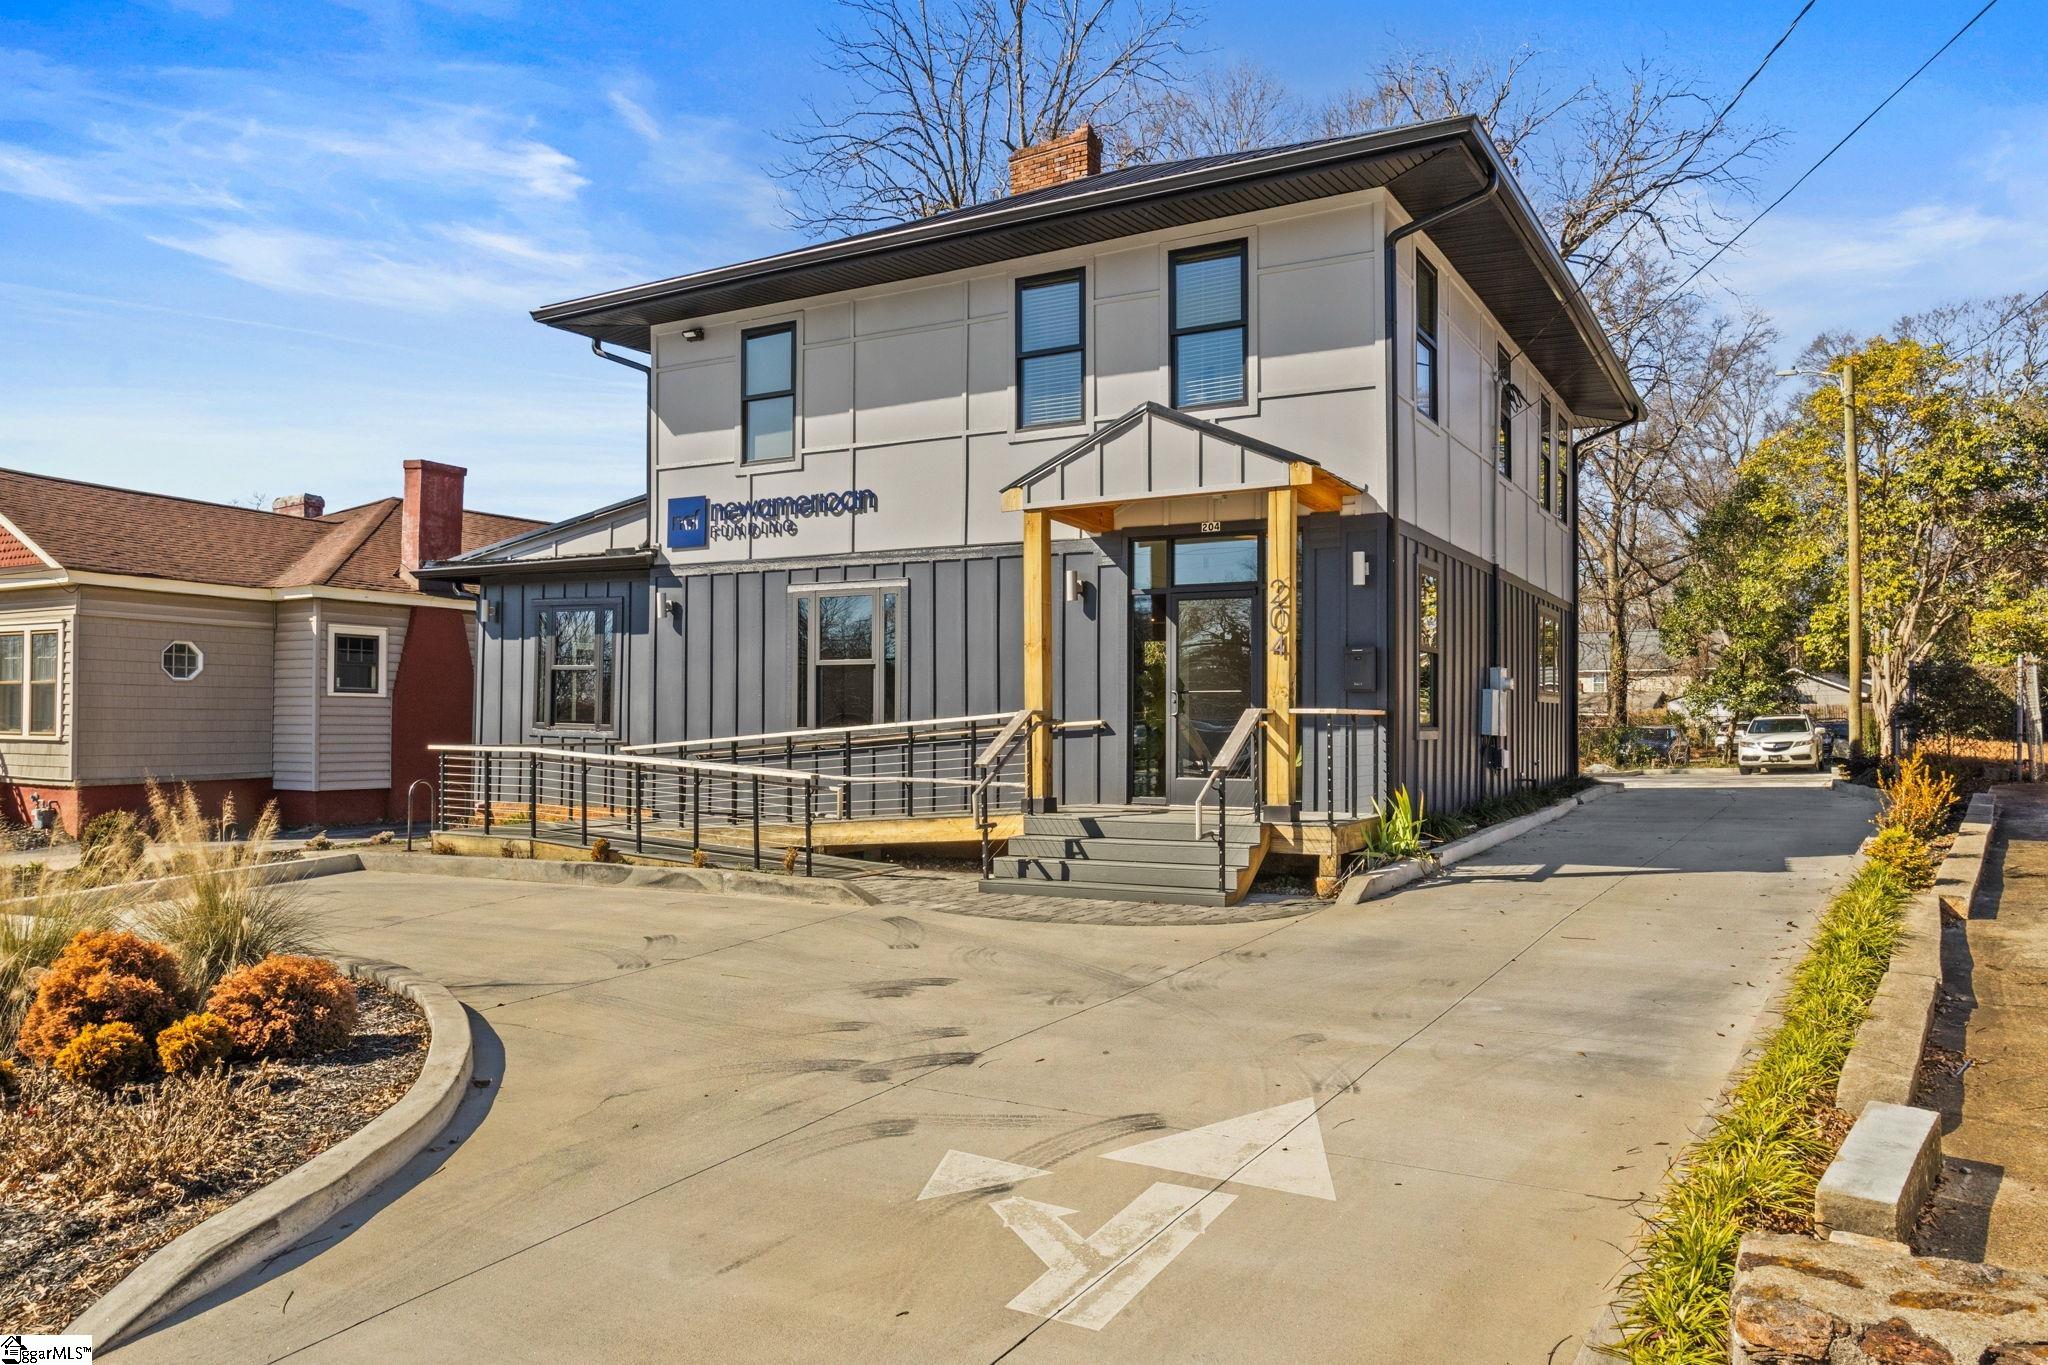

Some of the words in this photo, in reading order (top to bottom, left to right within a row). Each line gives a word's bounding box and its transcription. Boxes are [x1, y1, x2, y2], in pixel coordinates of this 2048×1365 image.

[711, 519, 798, 541] FUNDING
[1202, 523, 1219, 531] 204
[1270, 579, 1290, 656] 204
